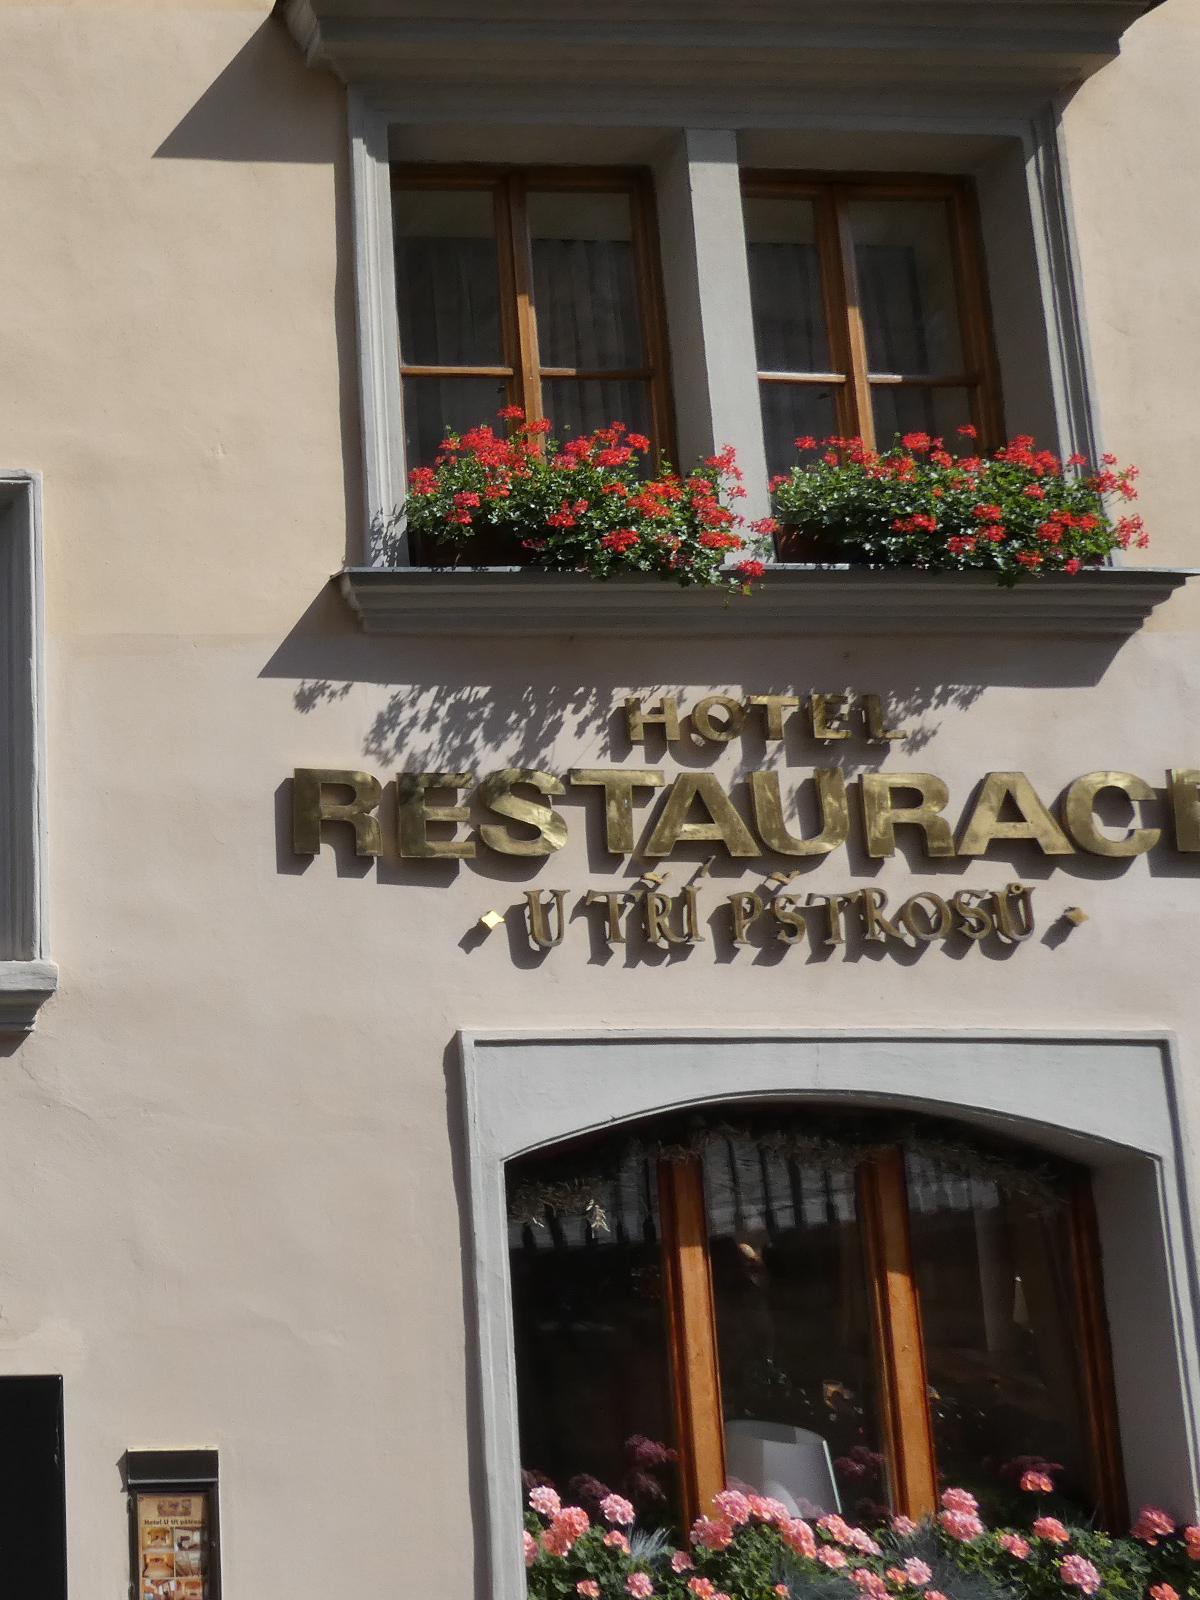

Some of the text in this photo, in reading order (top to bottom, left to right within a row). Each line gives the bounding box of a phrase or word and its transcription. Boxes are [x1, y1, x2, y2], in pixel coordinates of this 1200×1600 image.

[624, 693, 907, 743] HOTEL
[523, 887, 571, 948] U
[726, 870, 1036, 945] PŠTROSŮ
